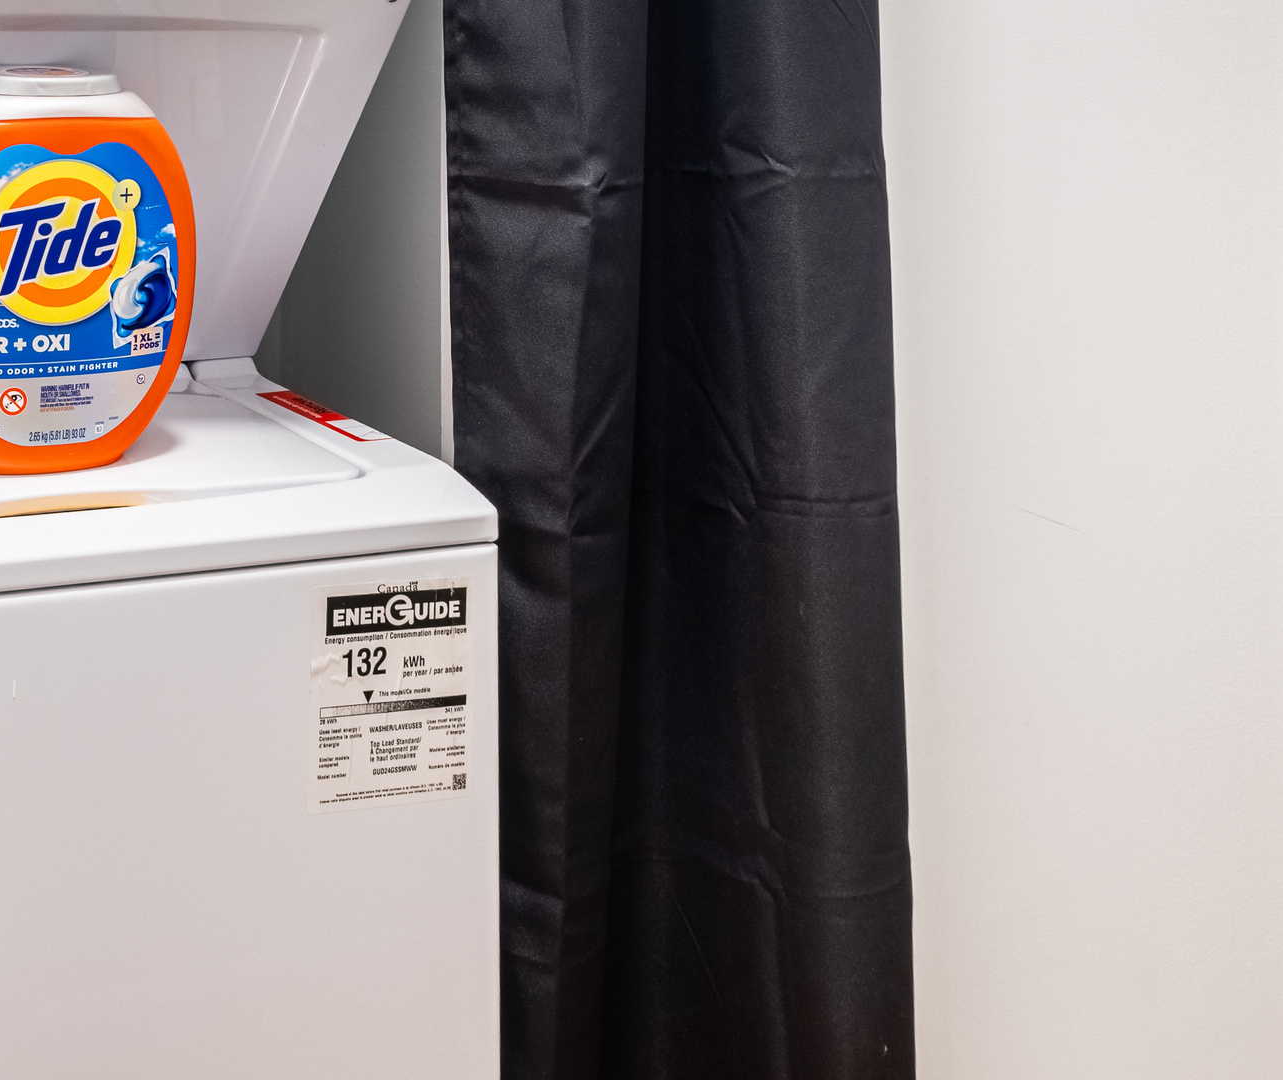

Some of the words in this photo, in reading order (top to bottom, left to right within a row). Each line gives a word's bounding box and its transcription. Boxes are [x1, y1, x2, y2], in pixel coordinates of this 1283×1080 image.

[13, 338, 27, 352] +
[32, 333, 71, 353] OXI
[133, 335, 137, 343] 1
[140, 333, 152, 342] XL
[139, 342, 159, 350] PODS
[7, 367, 35, 375] ODOR
[47, 365, 76, 373] STAIN
[79, 361, 119, 371] FIGHTER
[29, 432, 41, 442] 2.65
[41, 431, 48, 443] kg
[49, 430, 61, 442] (5.81
[62, 429, 71, 441] LB)
[72, 429, 78, 439] 93
[79, 428, 86, 438] OZ
[377, 582, 418, 594] Canada
[333, 594, 460, 627] ENERGUIDE
[325, 637, 345, 645] Energy
[346, 634, 383, 643] consumption
[389, 629, 432, 639] Consommation
[342, 646, 387, 677] 132
[403, 656, 425, 668] kWh
[414, 669, 427, 677] year
[369, 722, 423, 733] WASHER/LAVEUSES
[396, 737, 422, 745] Standard/
